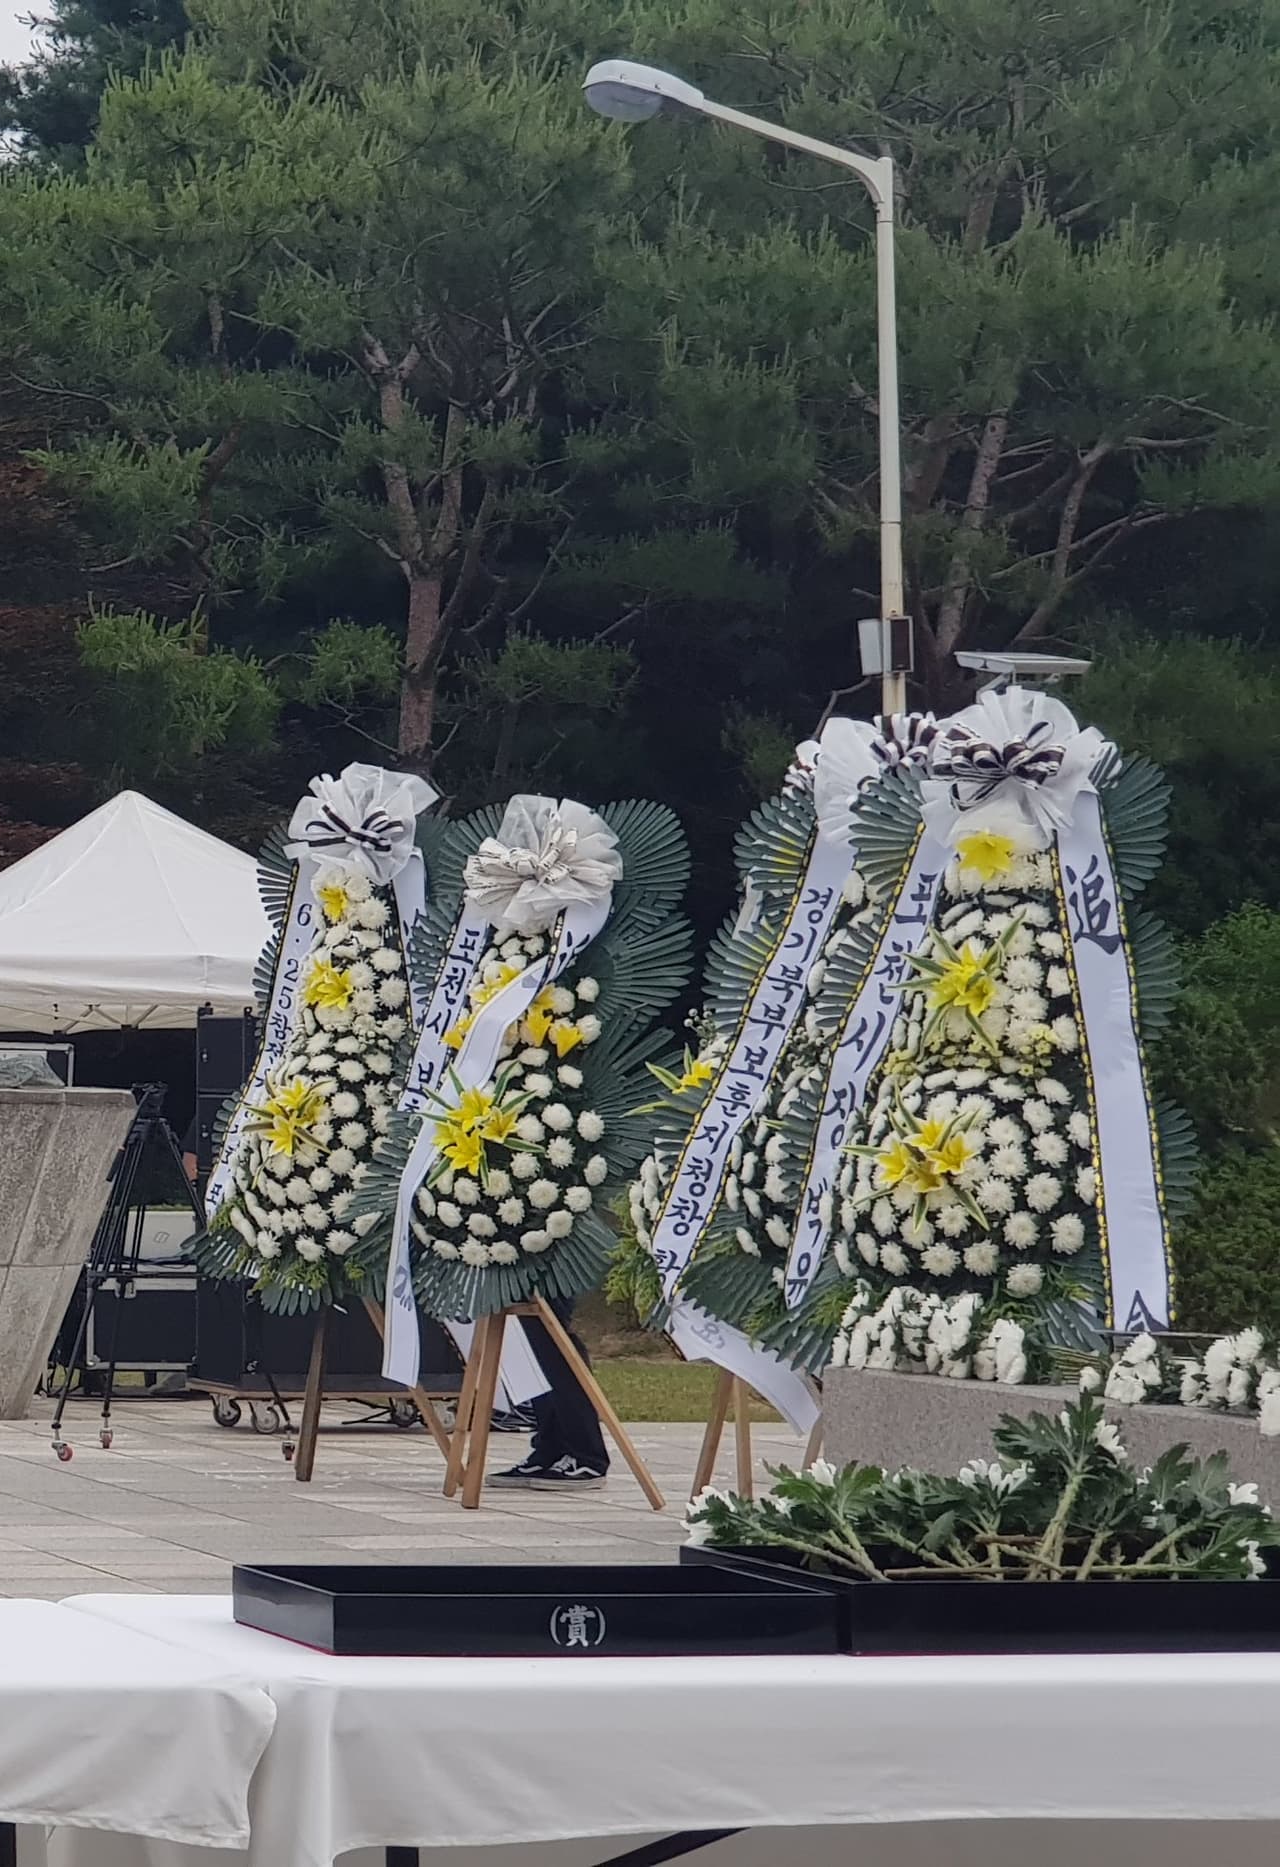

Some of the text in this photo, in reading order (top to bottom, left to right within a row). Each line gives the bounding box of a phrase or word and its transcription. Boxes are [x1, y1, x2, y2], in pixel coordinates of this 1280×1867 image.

[1065, 854, 1124, 955] 追
[426, 928, 480, 1039] 포천시
[822, 873, 938, 1150] 포천시장
